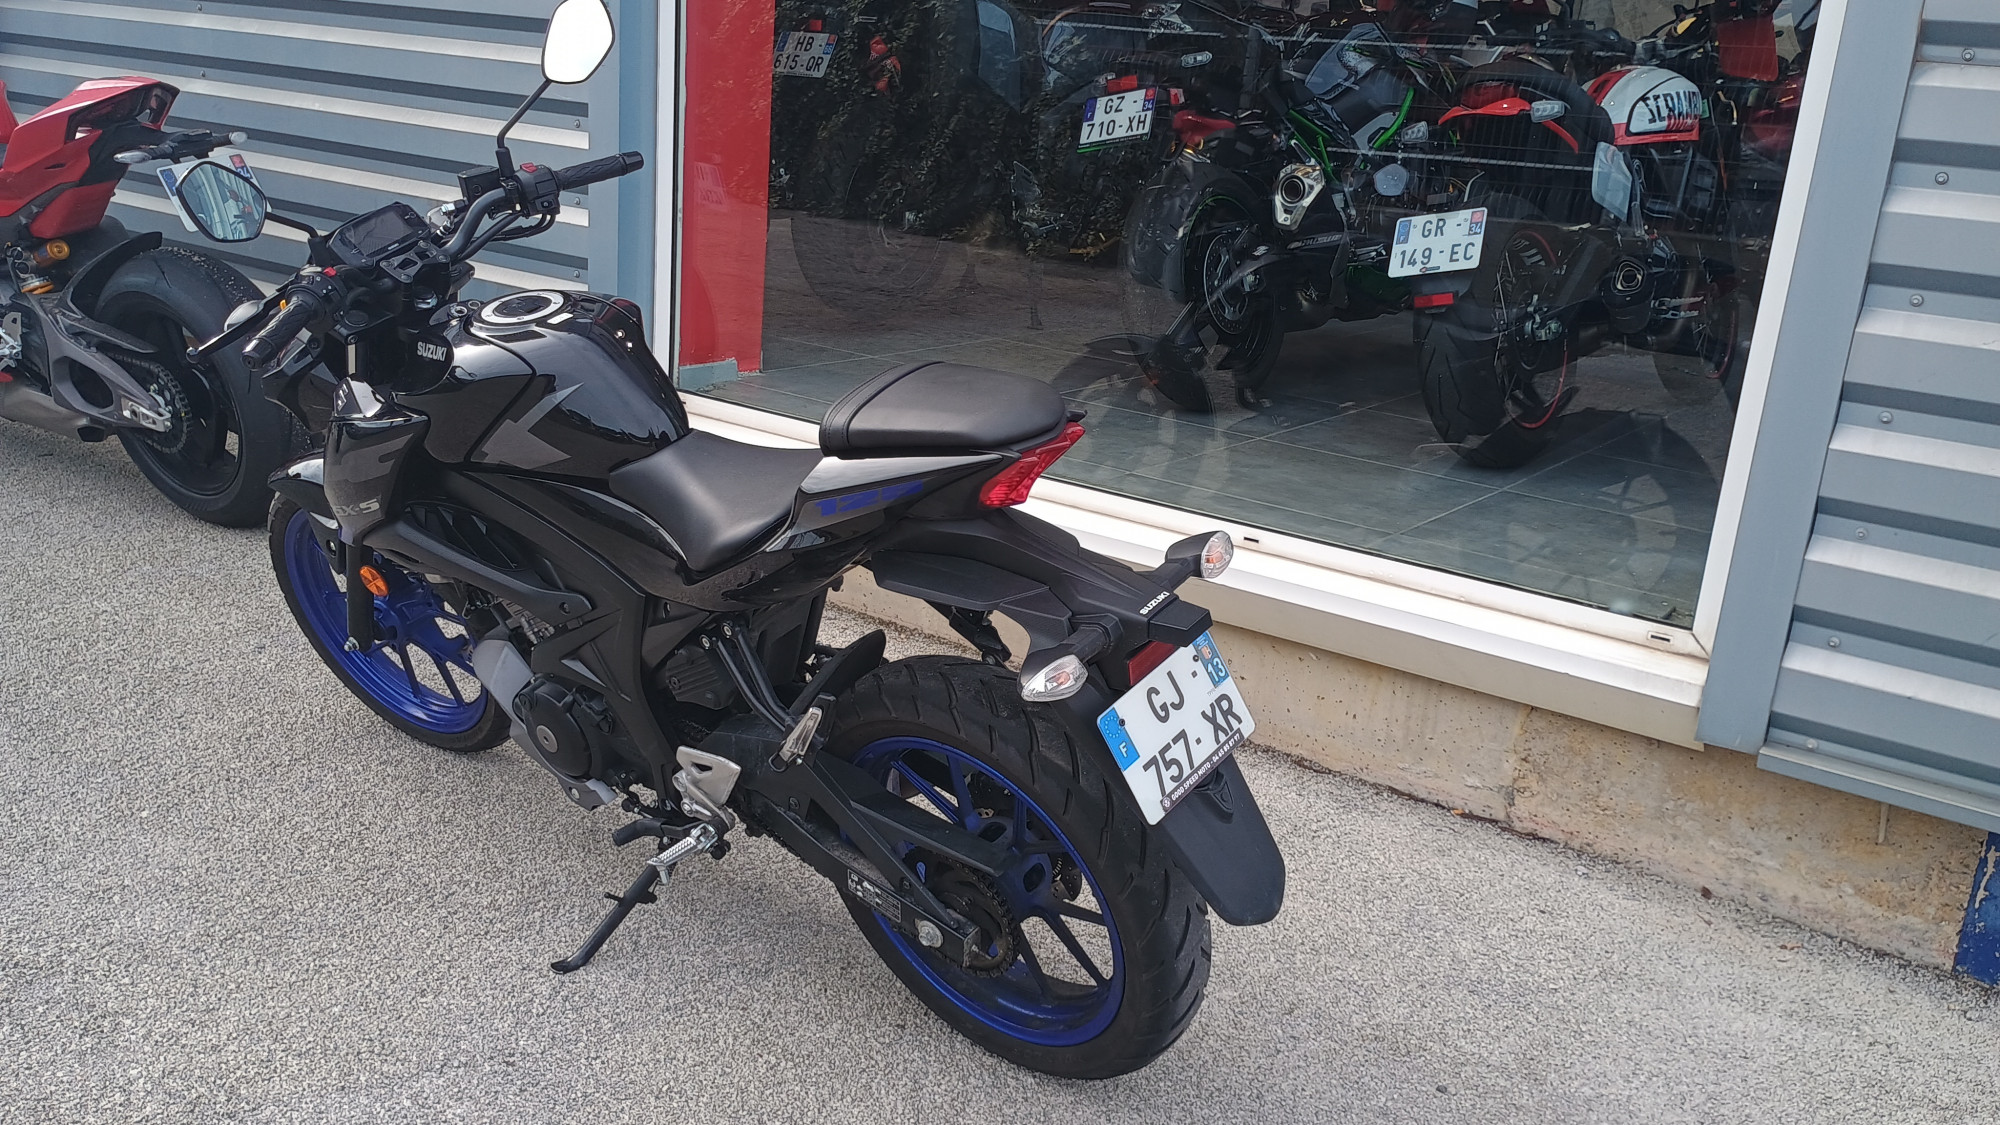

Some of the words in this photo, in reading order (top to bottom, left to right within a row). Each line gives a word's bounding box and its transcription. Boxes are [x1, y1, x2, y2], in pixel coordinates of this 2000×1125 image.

[794, 35, 815, 52] HB
[1104, 95, 1126, 115] GZ
[1143, 100, 1153, 110] 34
[1421, 218, 1447, 239] GR
[1469, 222, 1482, 234] 34
[417, 341, 448, 362] SUZUKI
[1139, 590, 1171, 615] SUZUKI
[1206, 657, 1226, 682] 13
[1146, 670, 1185, 724] GJ
[1118, 741, 1129, 758] F
[1171, 786, 1185, 801] GOOD
[1183, 773, 1199, 790] SPEED
[1197, 761, 1211, 777] MOTO
